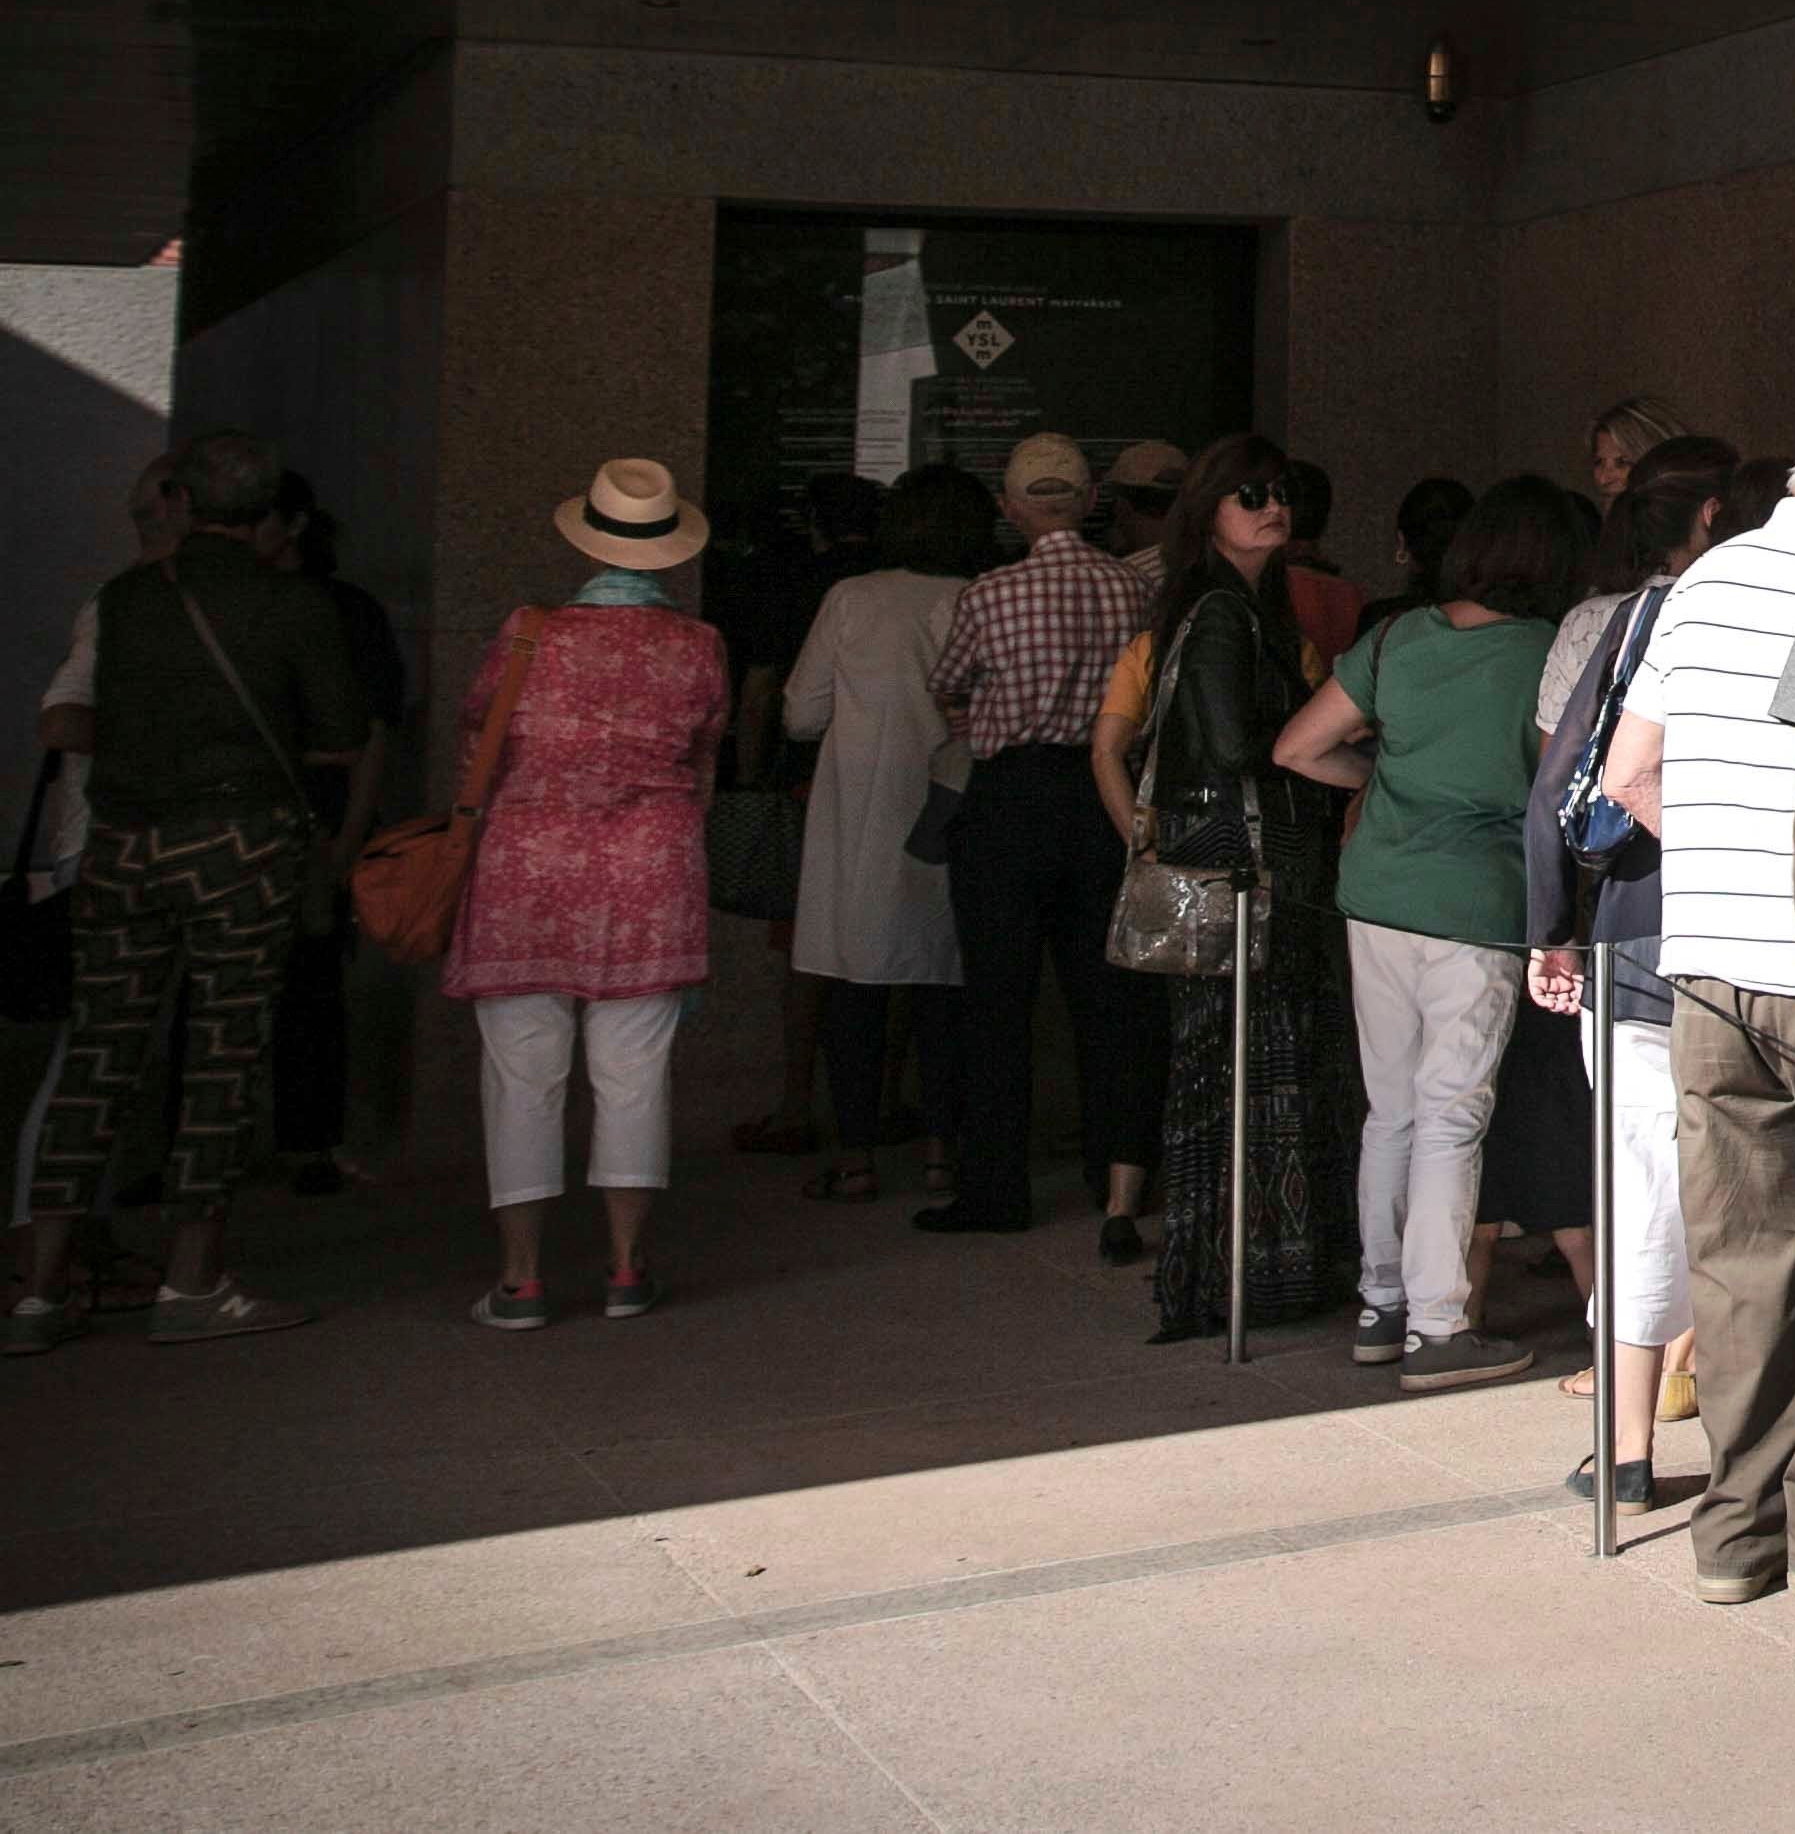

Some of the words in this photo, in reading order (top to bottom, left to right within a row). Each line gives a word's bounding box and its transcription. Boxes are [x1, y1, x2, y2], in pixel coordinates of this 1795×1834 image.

[936, 295, 977, 306] SAINT
[981, 295, 1044, 306] LAURENT
[967, 334, 1000, 347] YSL
